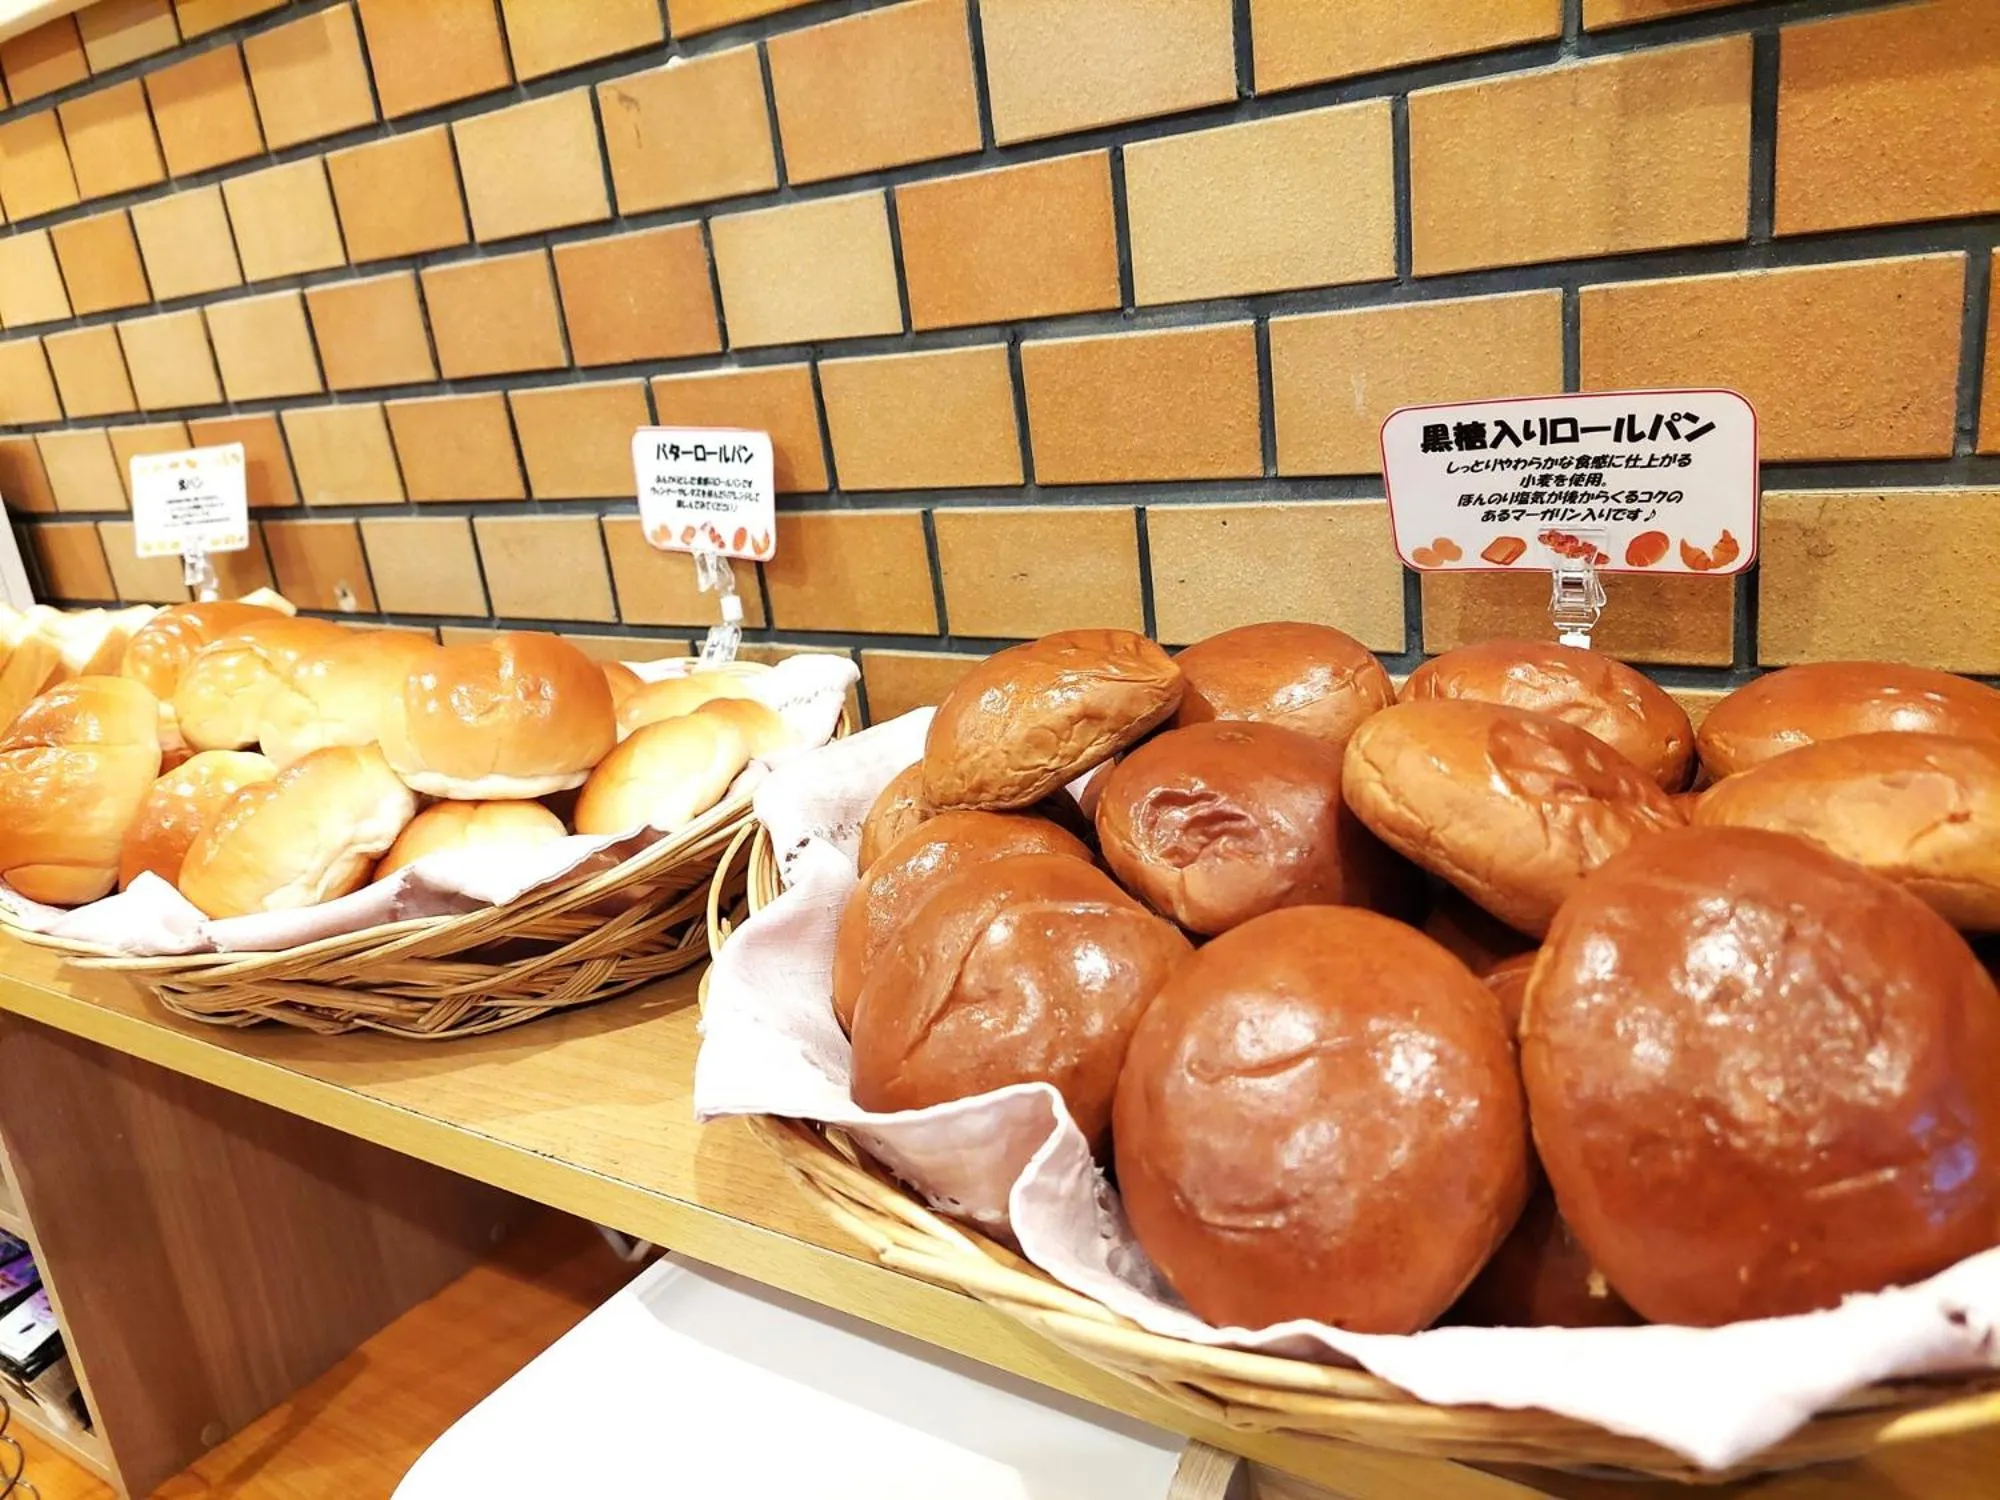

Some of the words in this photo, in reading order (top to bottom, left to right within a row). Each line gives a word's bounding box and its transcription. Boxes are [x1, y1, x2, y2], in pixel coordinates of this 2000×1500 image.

[1421, 411, 1716, 454] 黒糖入りロールパン
[656, 443, 754, 465] バターロールパン
[1446, 453, 1692, 475] しっとりやわらかな食感に仕上がる
[1519, 472, 1608, 489] 小麦を使用。
[1457, 490, 1683, 507] ほんのり塩気が後からくるコクの
